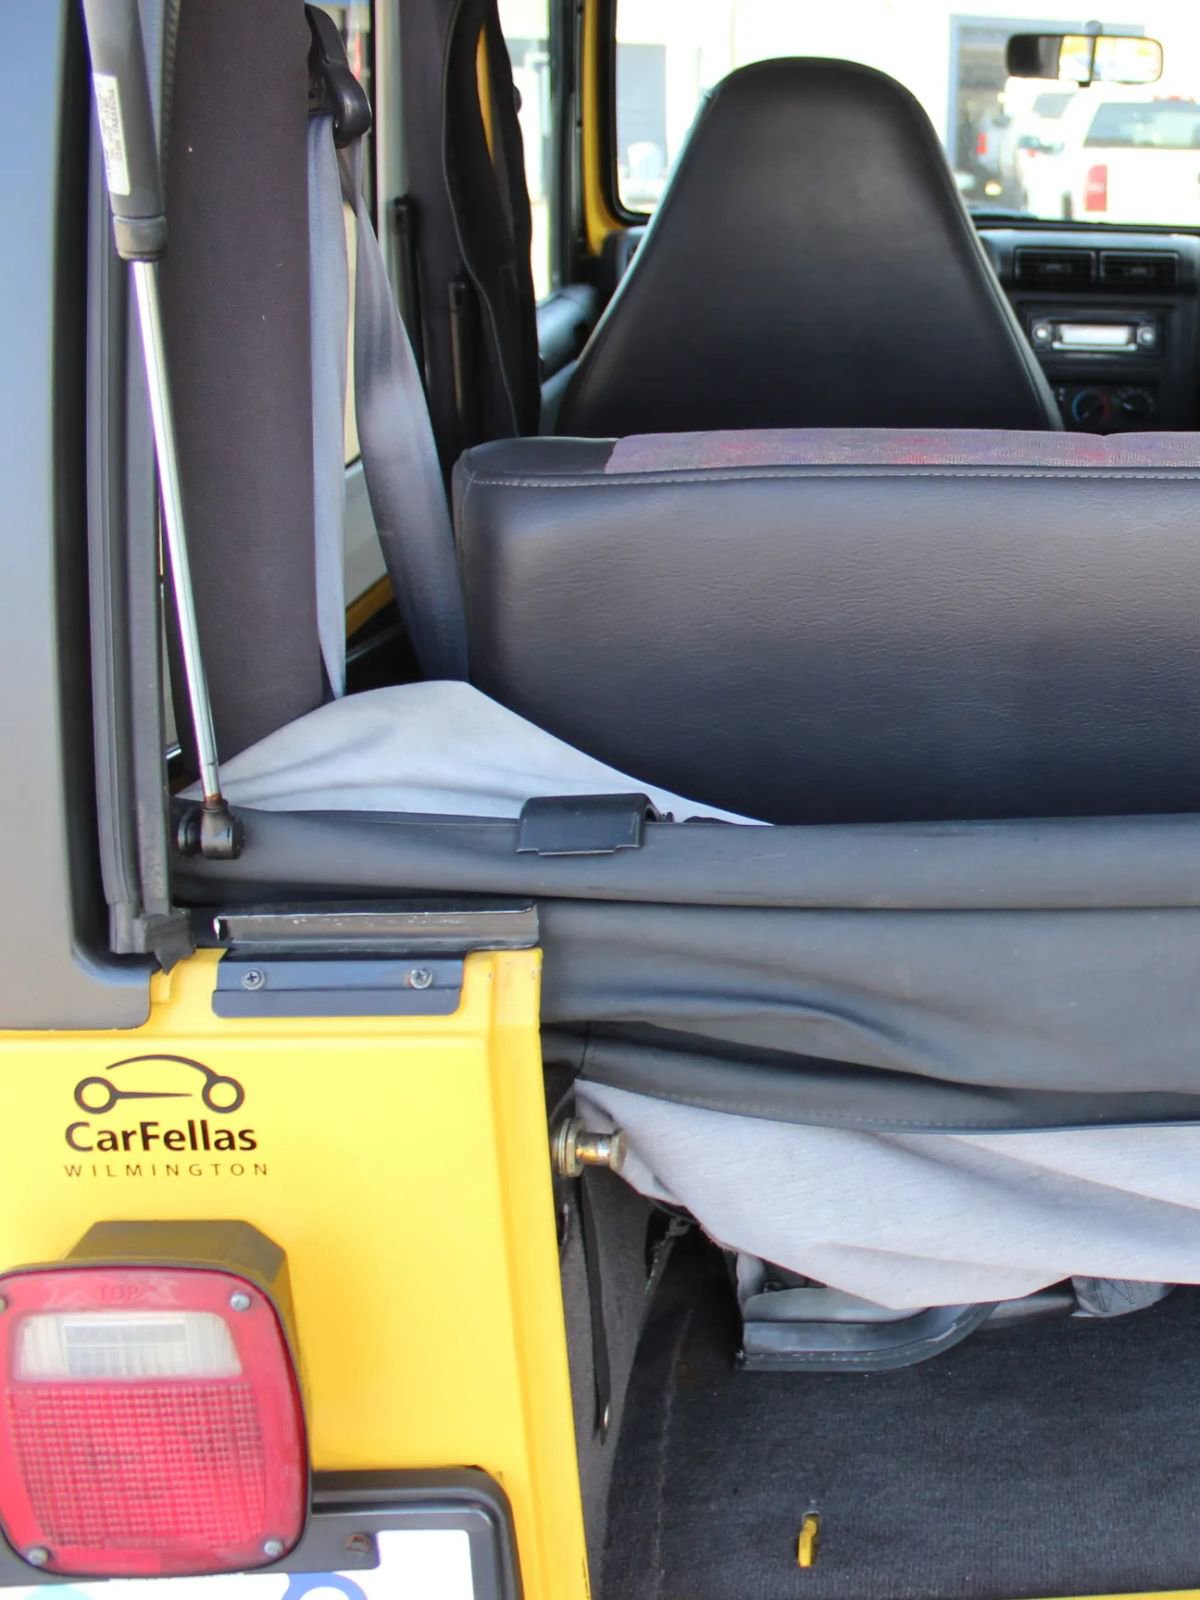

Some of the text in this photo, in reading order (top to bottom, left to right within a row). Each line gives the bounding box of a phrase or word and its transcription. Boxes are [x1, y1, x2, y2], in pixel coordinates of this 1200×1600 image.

[64, 1119, 258, 1153] CarFellas
[64, 1163, 268, 1177] WILMINGTON
[96, 1284, 139, 1301] TOP
